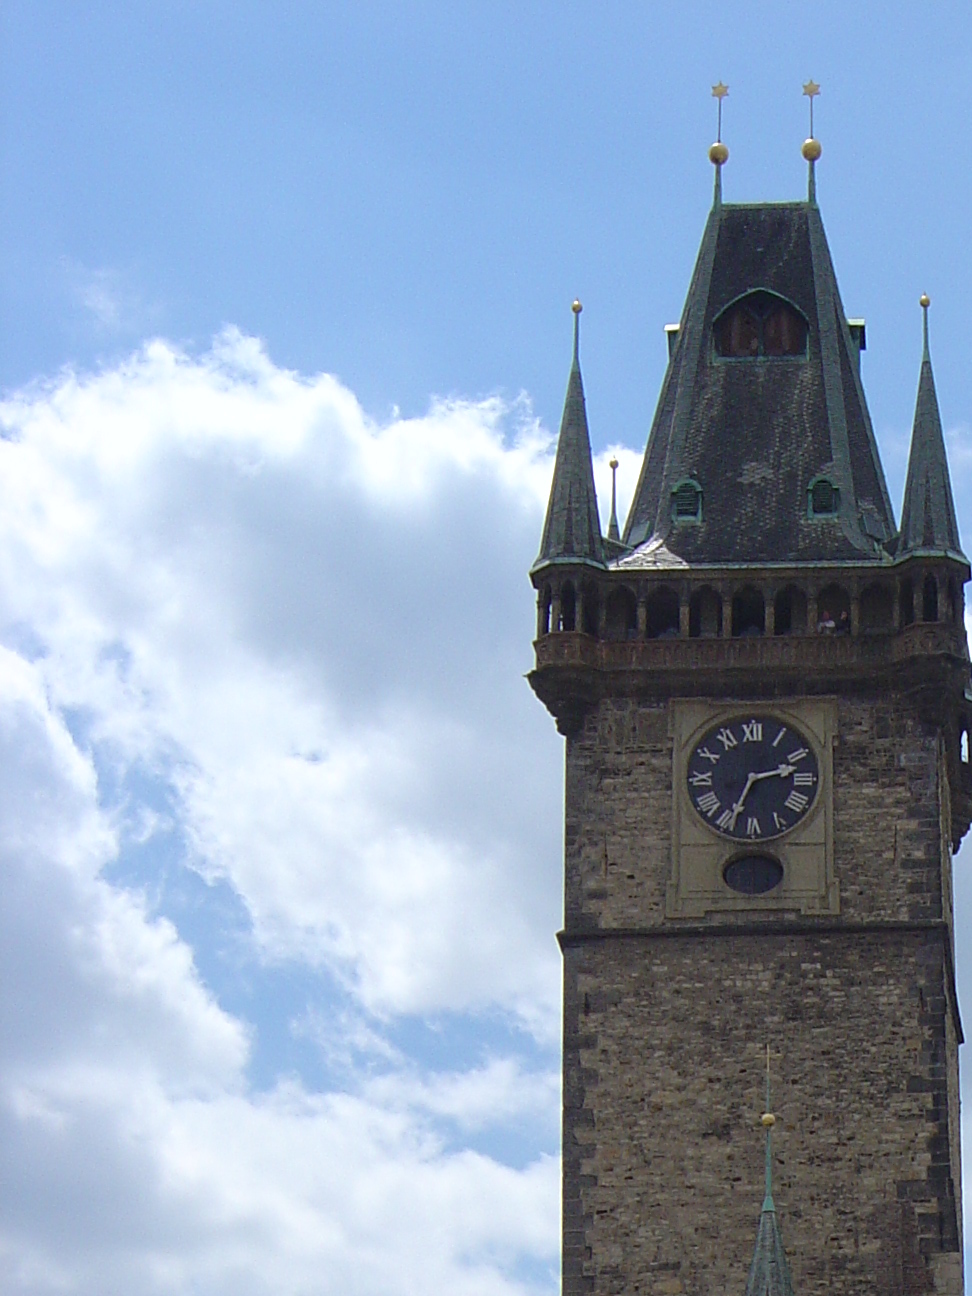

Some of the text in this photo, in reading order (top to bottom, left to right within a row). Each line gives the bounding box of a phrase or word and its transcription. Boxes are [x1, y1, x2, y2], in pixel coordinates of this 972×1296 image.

[717, 729, 738, 750] XI
[742, 723, 762, 743] XII
[700, 748, 720, 764] X
[787, 748, 807, 763] II
[693, 771, 712, 786] IX
[793, 772, 813, 786] III
[697, 791, 721, 817] VIII
[784, 790, 809, 812] IIII
[746, 818, 761, 834] VI
